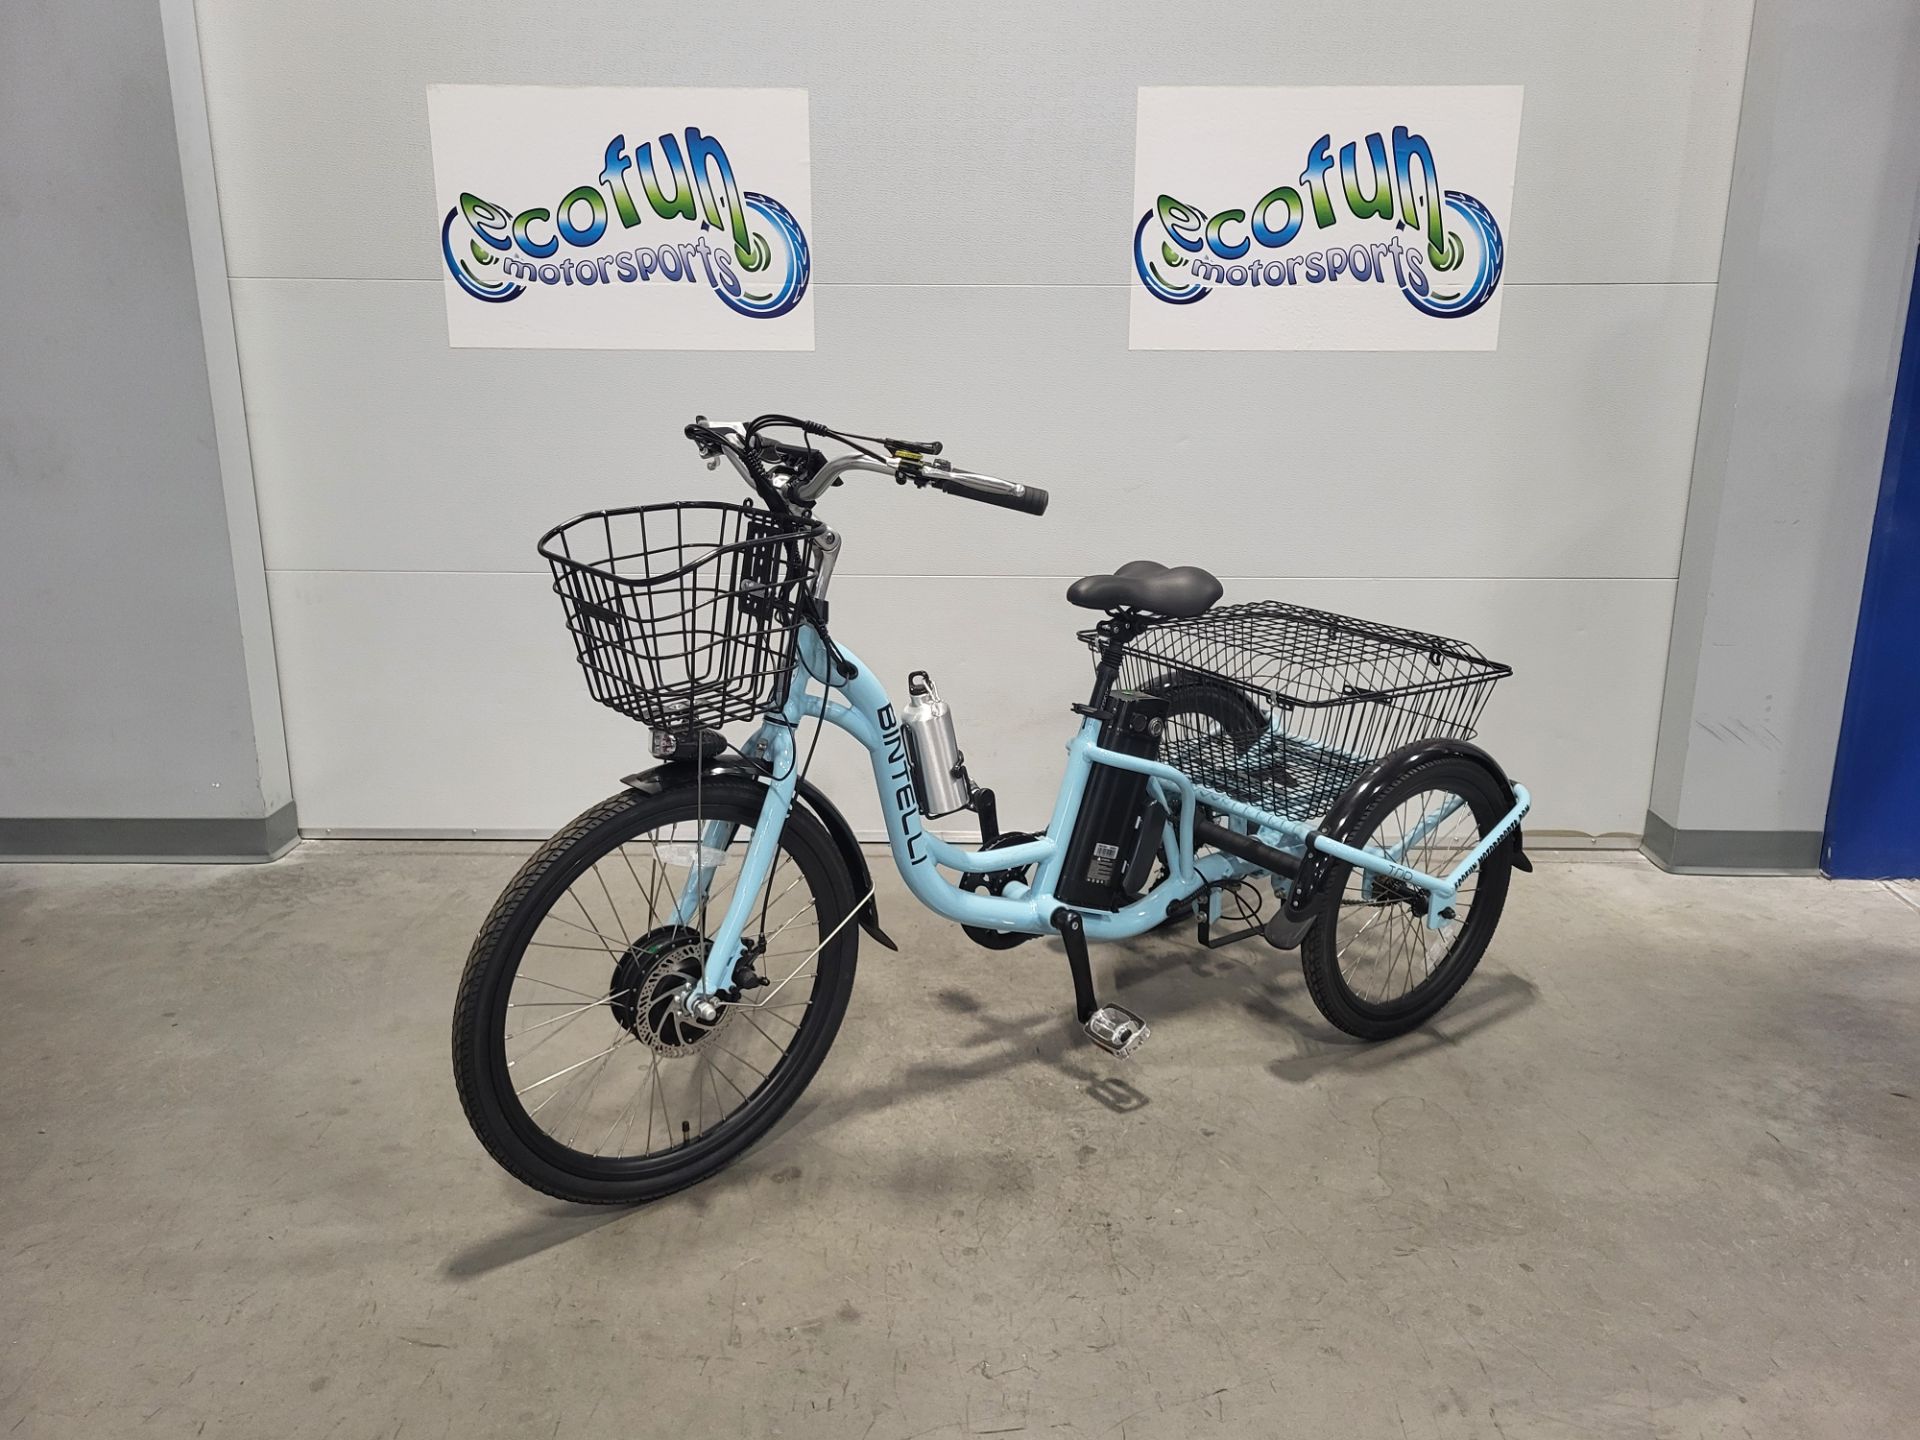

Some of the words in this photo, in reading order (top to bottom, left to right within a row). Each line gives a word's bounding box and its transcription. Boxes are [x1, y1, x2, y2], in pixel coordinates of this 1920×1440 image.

[459, 126, 752, 259] ecofun
[1157, 125, 1445, 260] ecofun
[503, 235, 742, 297] motorsports
[1191, 235, 1431, 297] motorsports
[876, 702, 928, 866] BINTELLI
